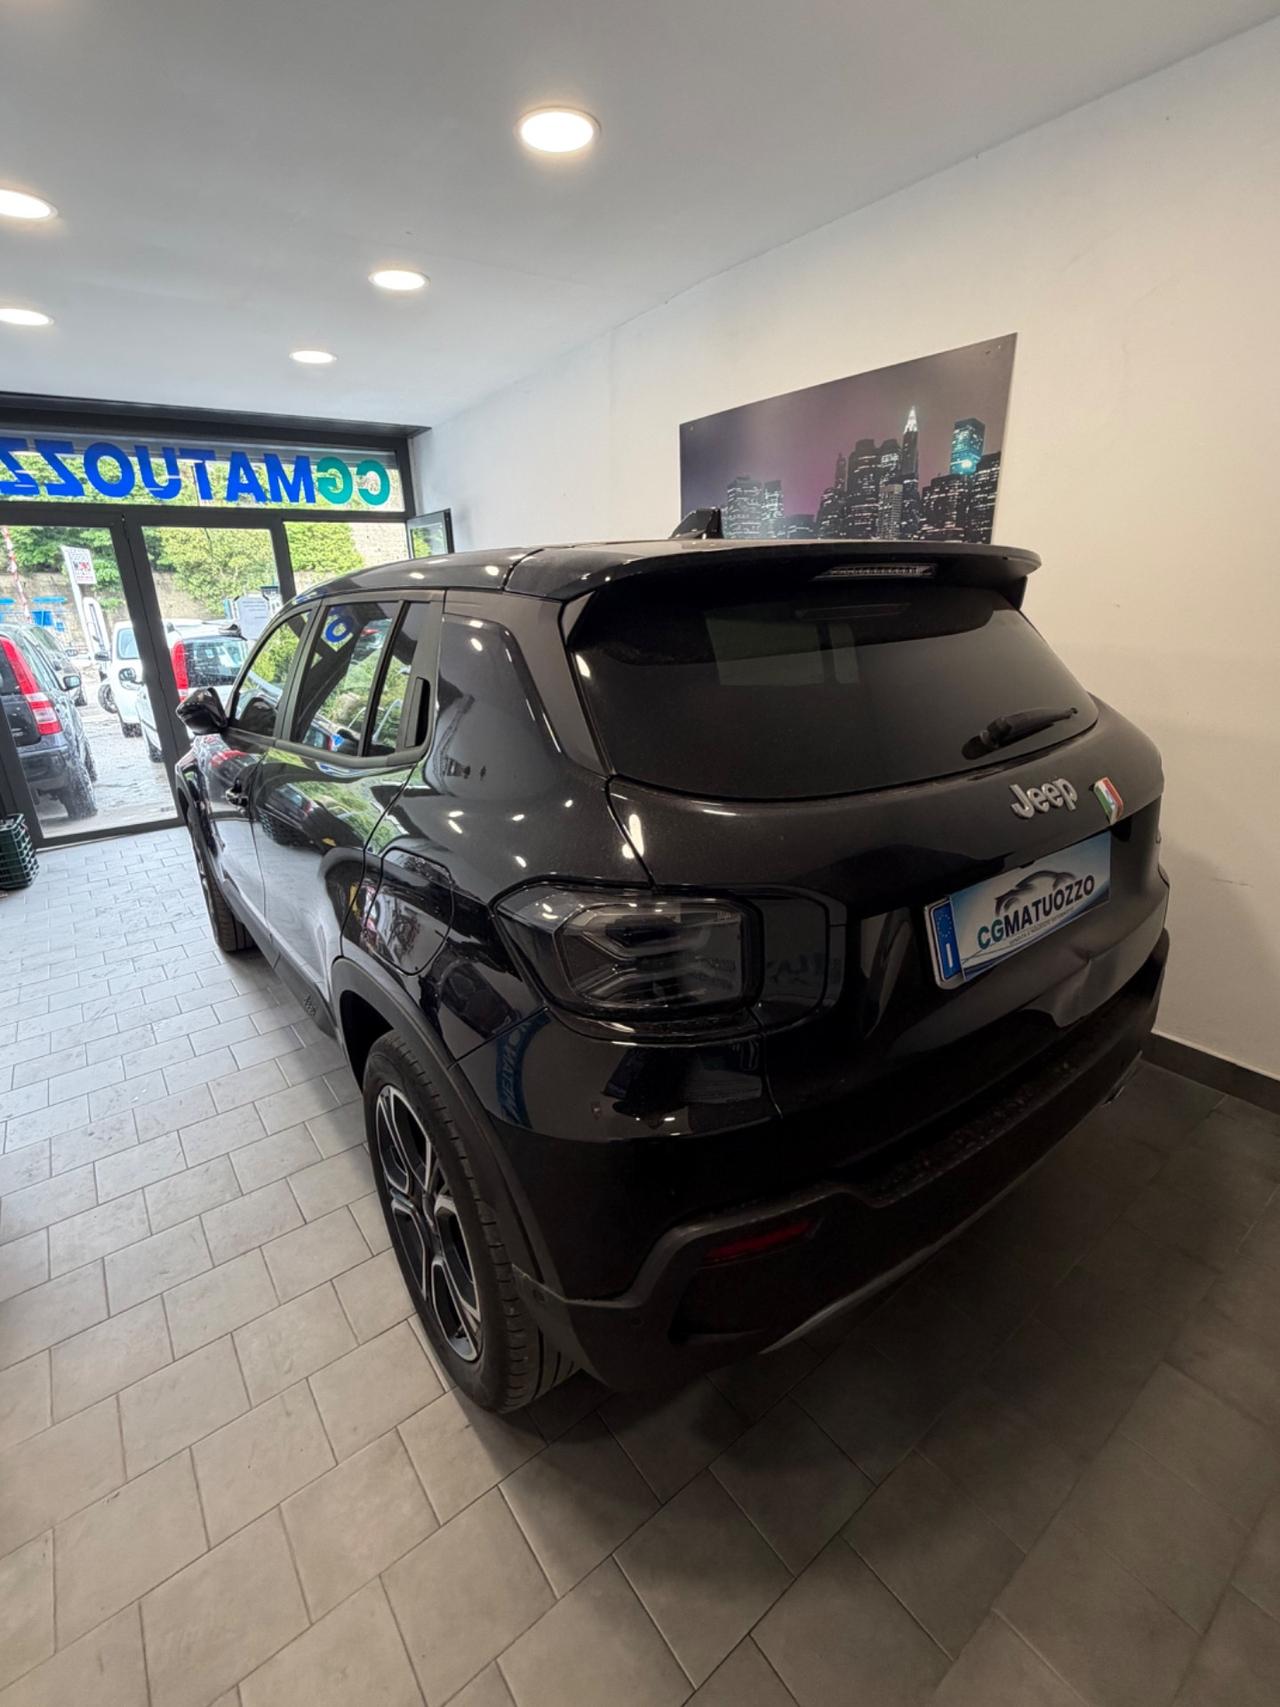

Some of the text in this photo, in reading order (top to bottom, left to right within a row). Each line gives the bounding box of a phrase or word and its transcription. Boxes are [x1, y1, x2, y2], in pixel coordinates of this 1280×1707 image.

[1009, 778, 1078, 819] Jeep
[976, 875, 1095, 950] CGMATUOZZO
[945, 943, 953, 968] I
